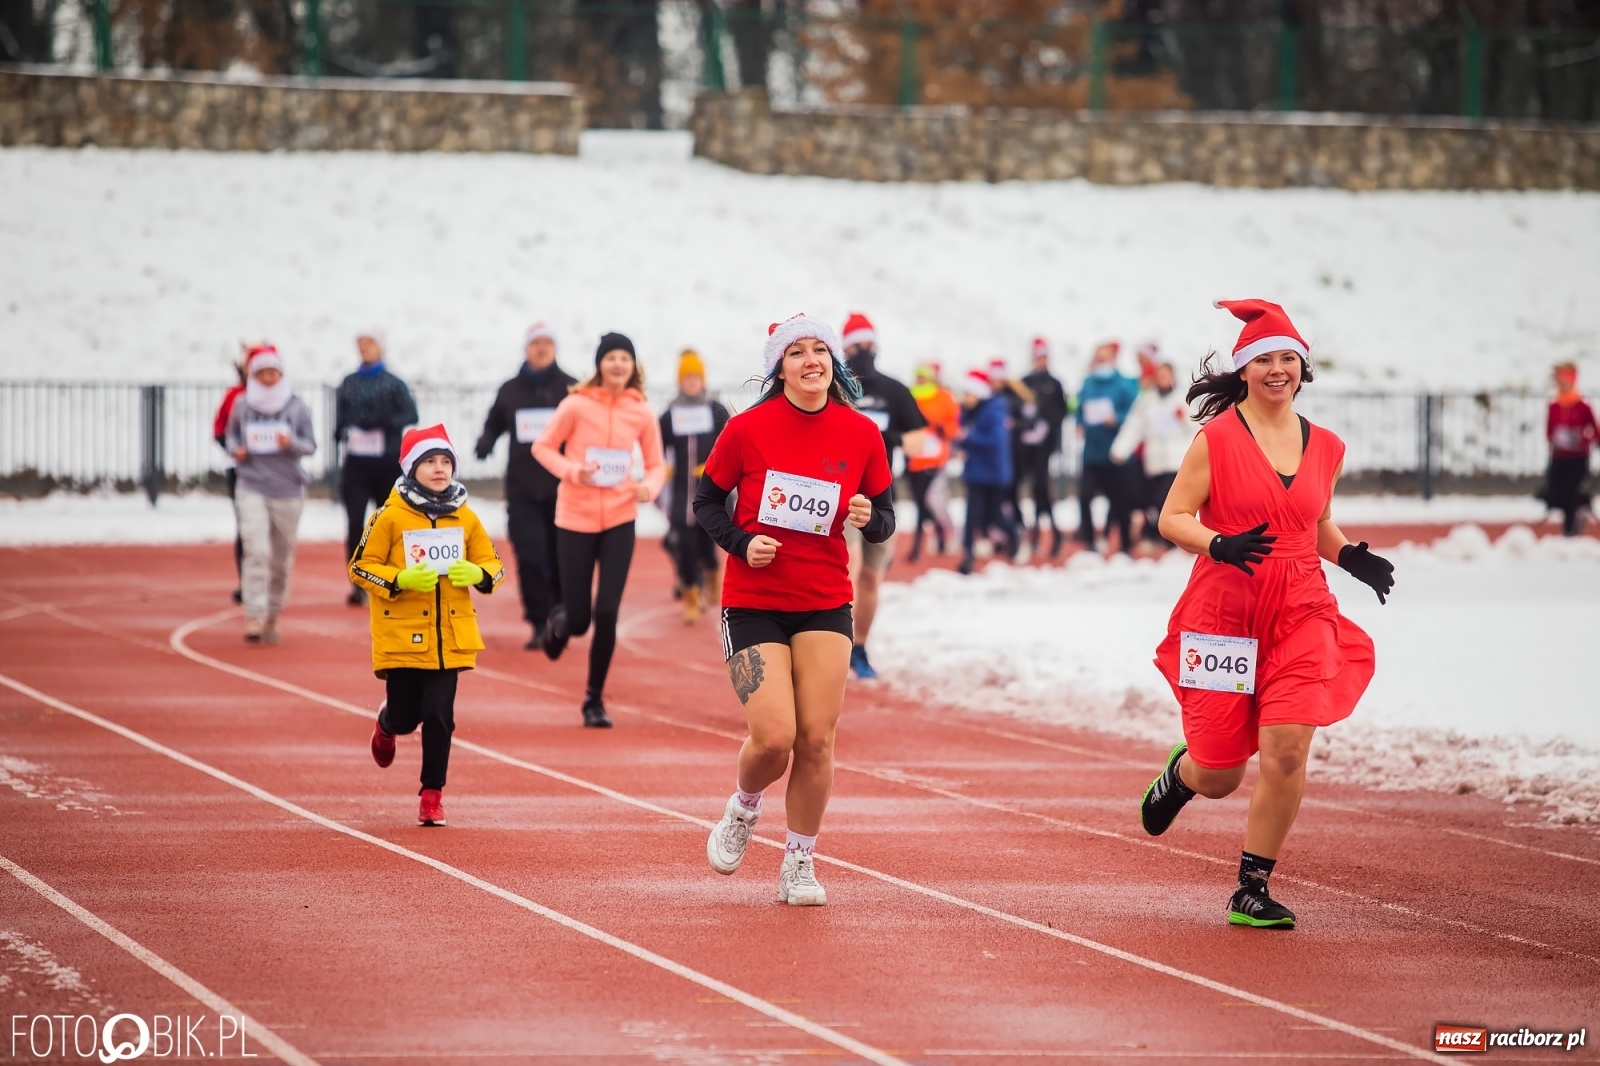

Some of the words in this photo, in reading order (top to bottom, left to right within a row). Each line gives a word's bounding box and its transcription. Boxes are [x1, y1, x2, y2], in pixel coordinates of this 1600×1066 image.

[788, 494, 830, 518] 049
[428, 544, 459, 560] 008
[1204, 653, 1249, 675] 046
